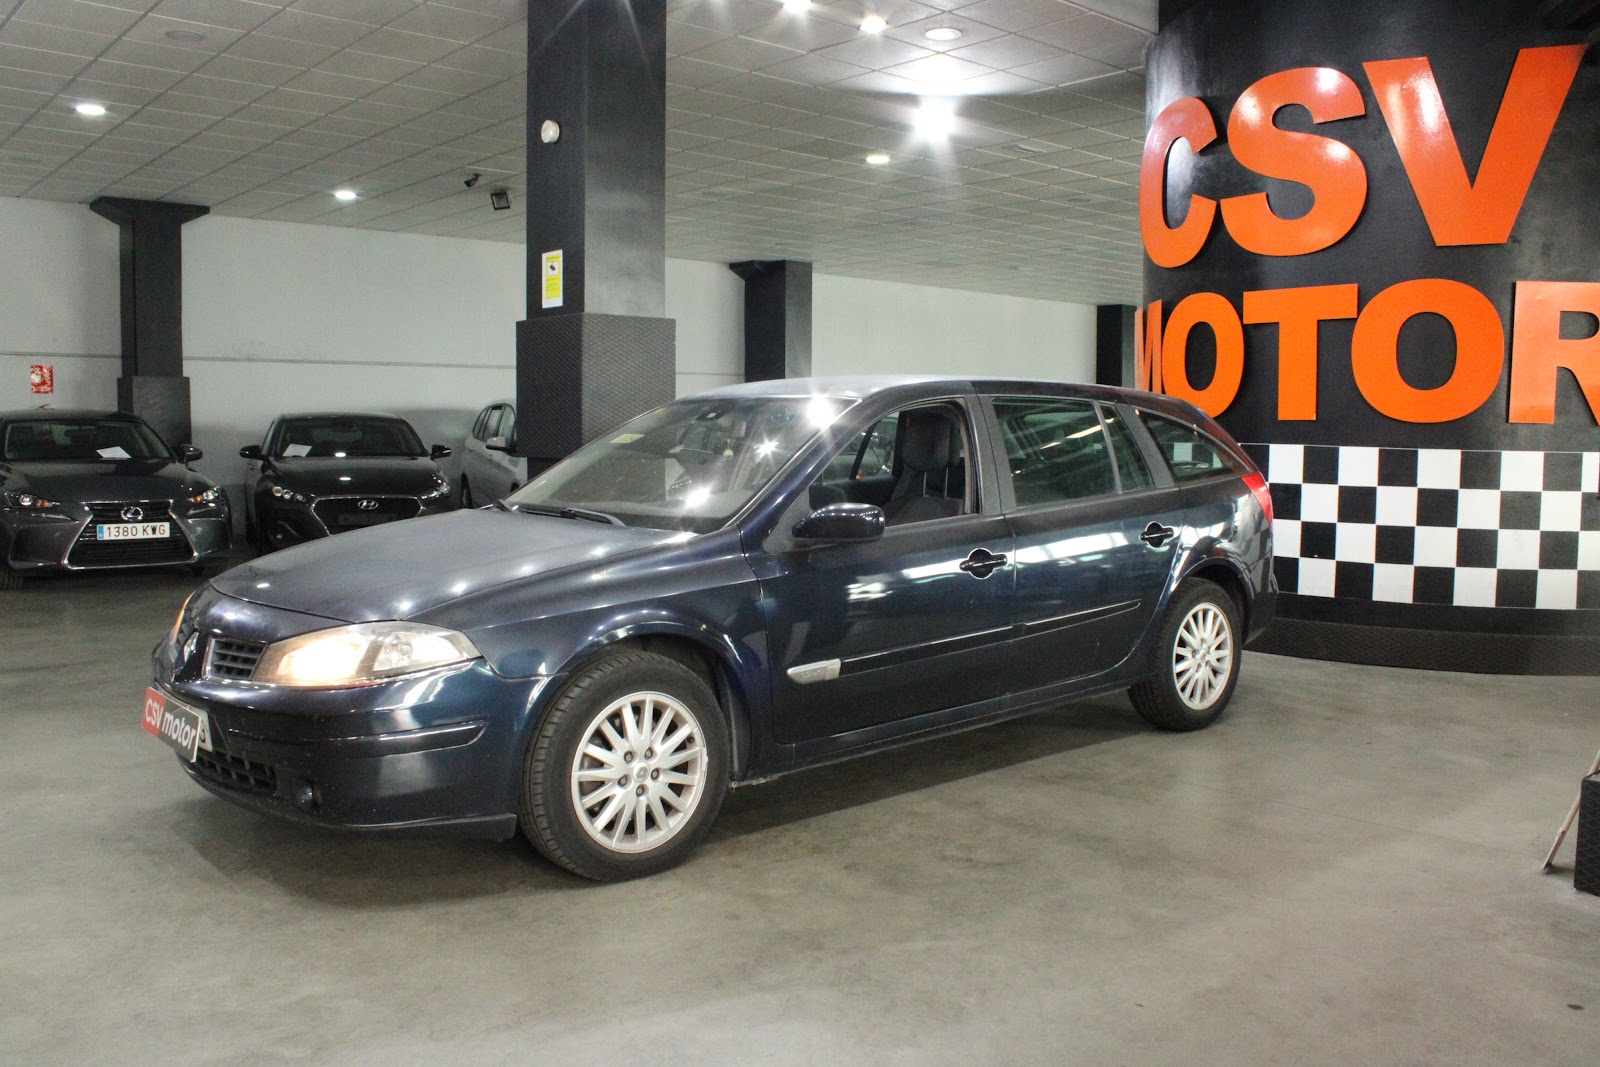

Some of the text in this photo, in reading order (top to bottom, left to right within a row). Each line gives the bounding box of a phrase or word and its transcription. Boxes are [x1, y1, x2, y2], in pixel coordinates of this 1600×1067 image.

[1139, 43, 1589, 268] CSV
[1134, 278, 1600, 424] MOTOR
[107, 525, 166, 537] 1380 KWG
[145, 698, 164, 729] CSV
[161, 711, 196, 749] motor
